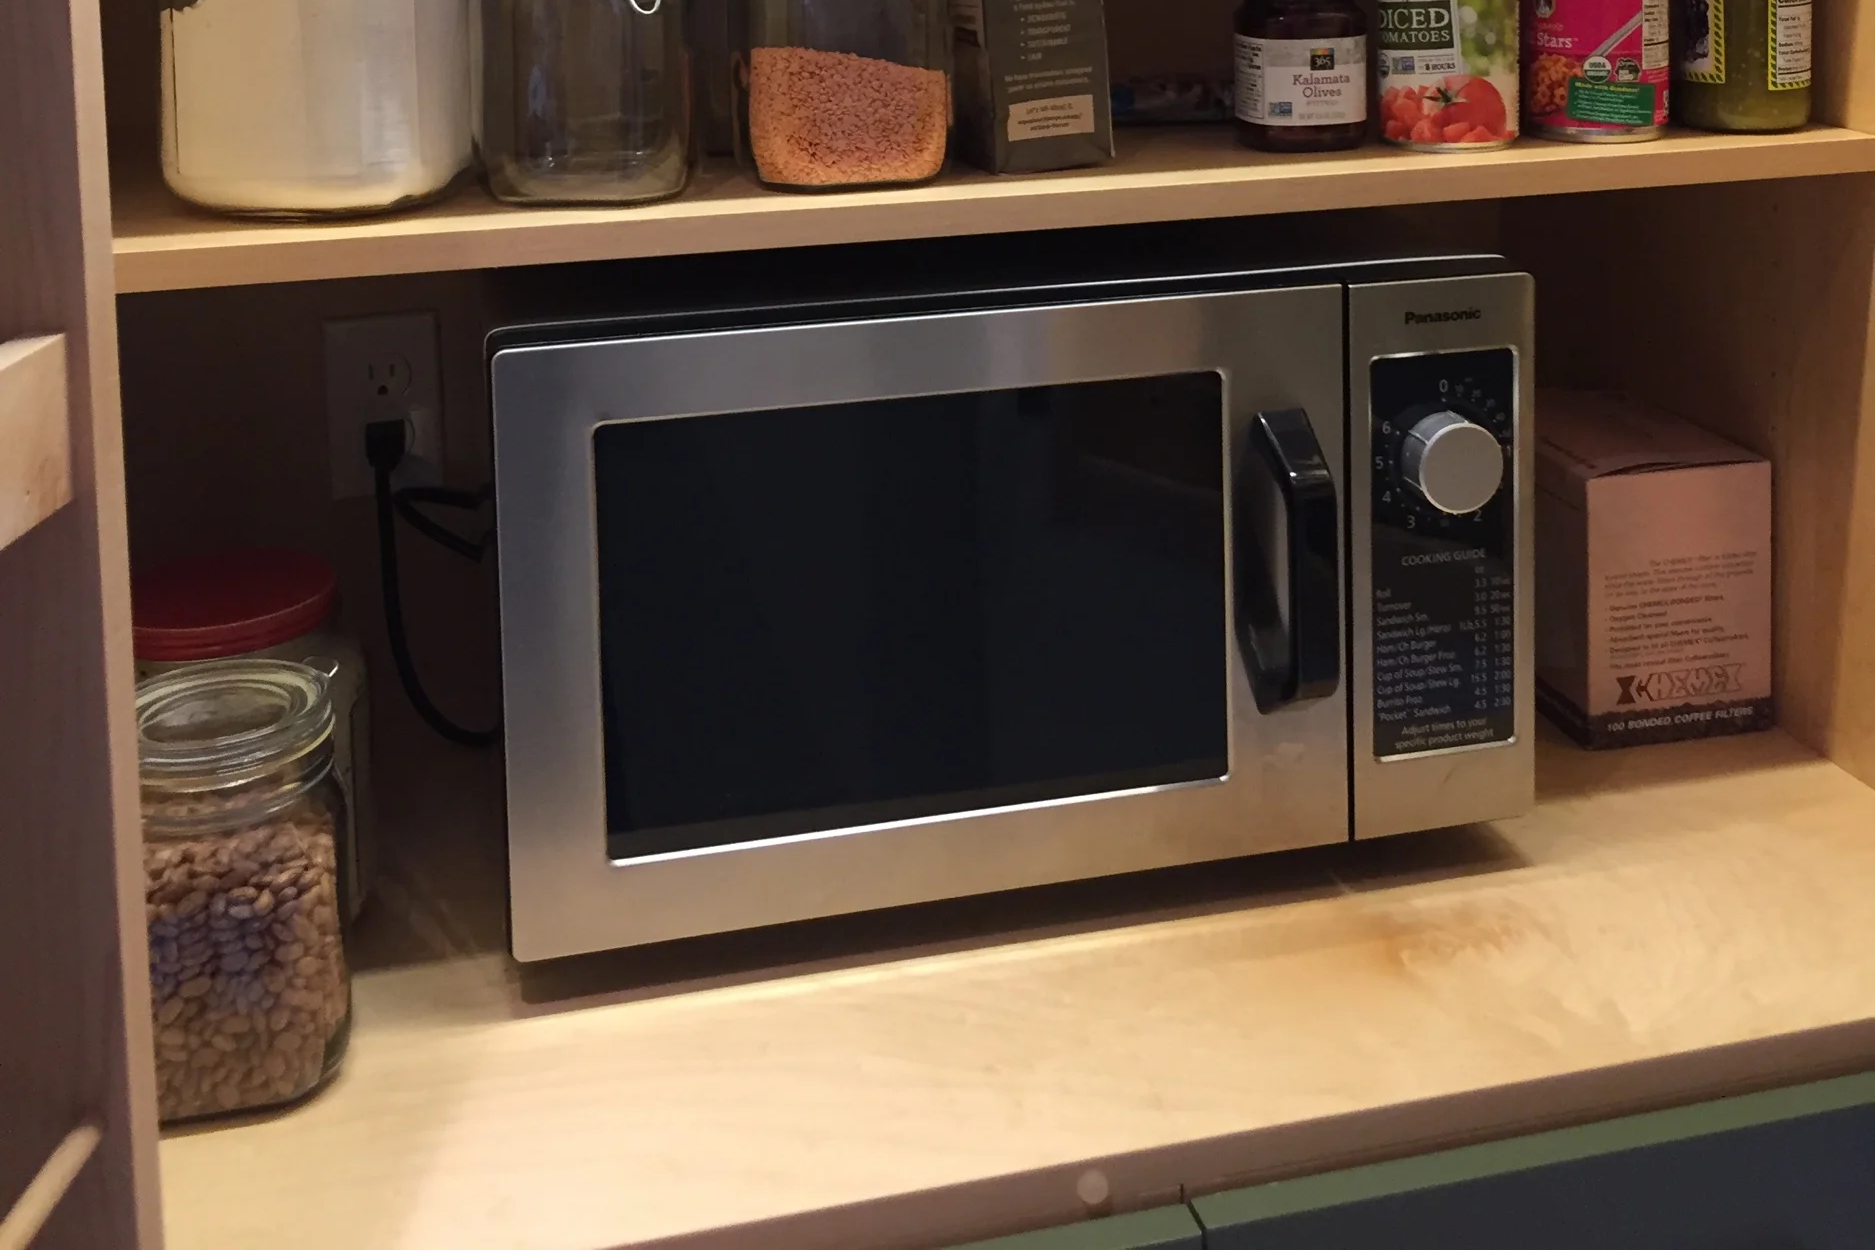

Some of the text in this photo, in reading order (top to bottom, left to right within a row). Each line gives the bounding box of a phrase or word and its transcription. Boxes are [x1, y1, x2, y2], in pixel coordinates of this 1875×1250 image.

[1536, 32, 1573, 48] Stars
[1314, 56, 1332, 68] 365
[1431, 62, 1456, 71] HOURS
[1292, 73, 1351, 86] Kalamata
[1302, 86, 1342, 99] Olives
[1405, 307, 1482, 325] Panasonic
[1438, 379, 1449, 393] 0
[1381, 421, 1391, 434] 6
[1374, 456, 1384, 469] 5
[1381, 491, 1391, 503] 4
[1406, 515, 1416, 529] 3
[1473, 509, 1482, 522] 2
[1401, 548, 1486, 567] COOKING GUIDE
[1607, 706, 1753, 732] 100 BONDED COFFEE FILTERS
[1428, 730, 1463, 746] product
[1464, 727, 1494, 742] weight
